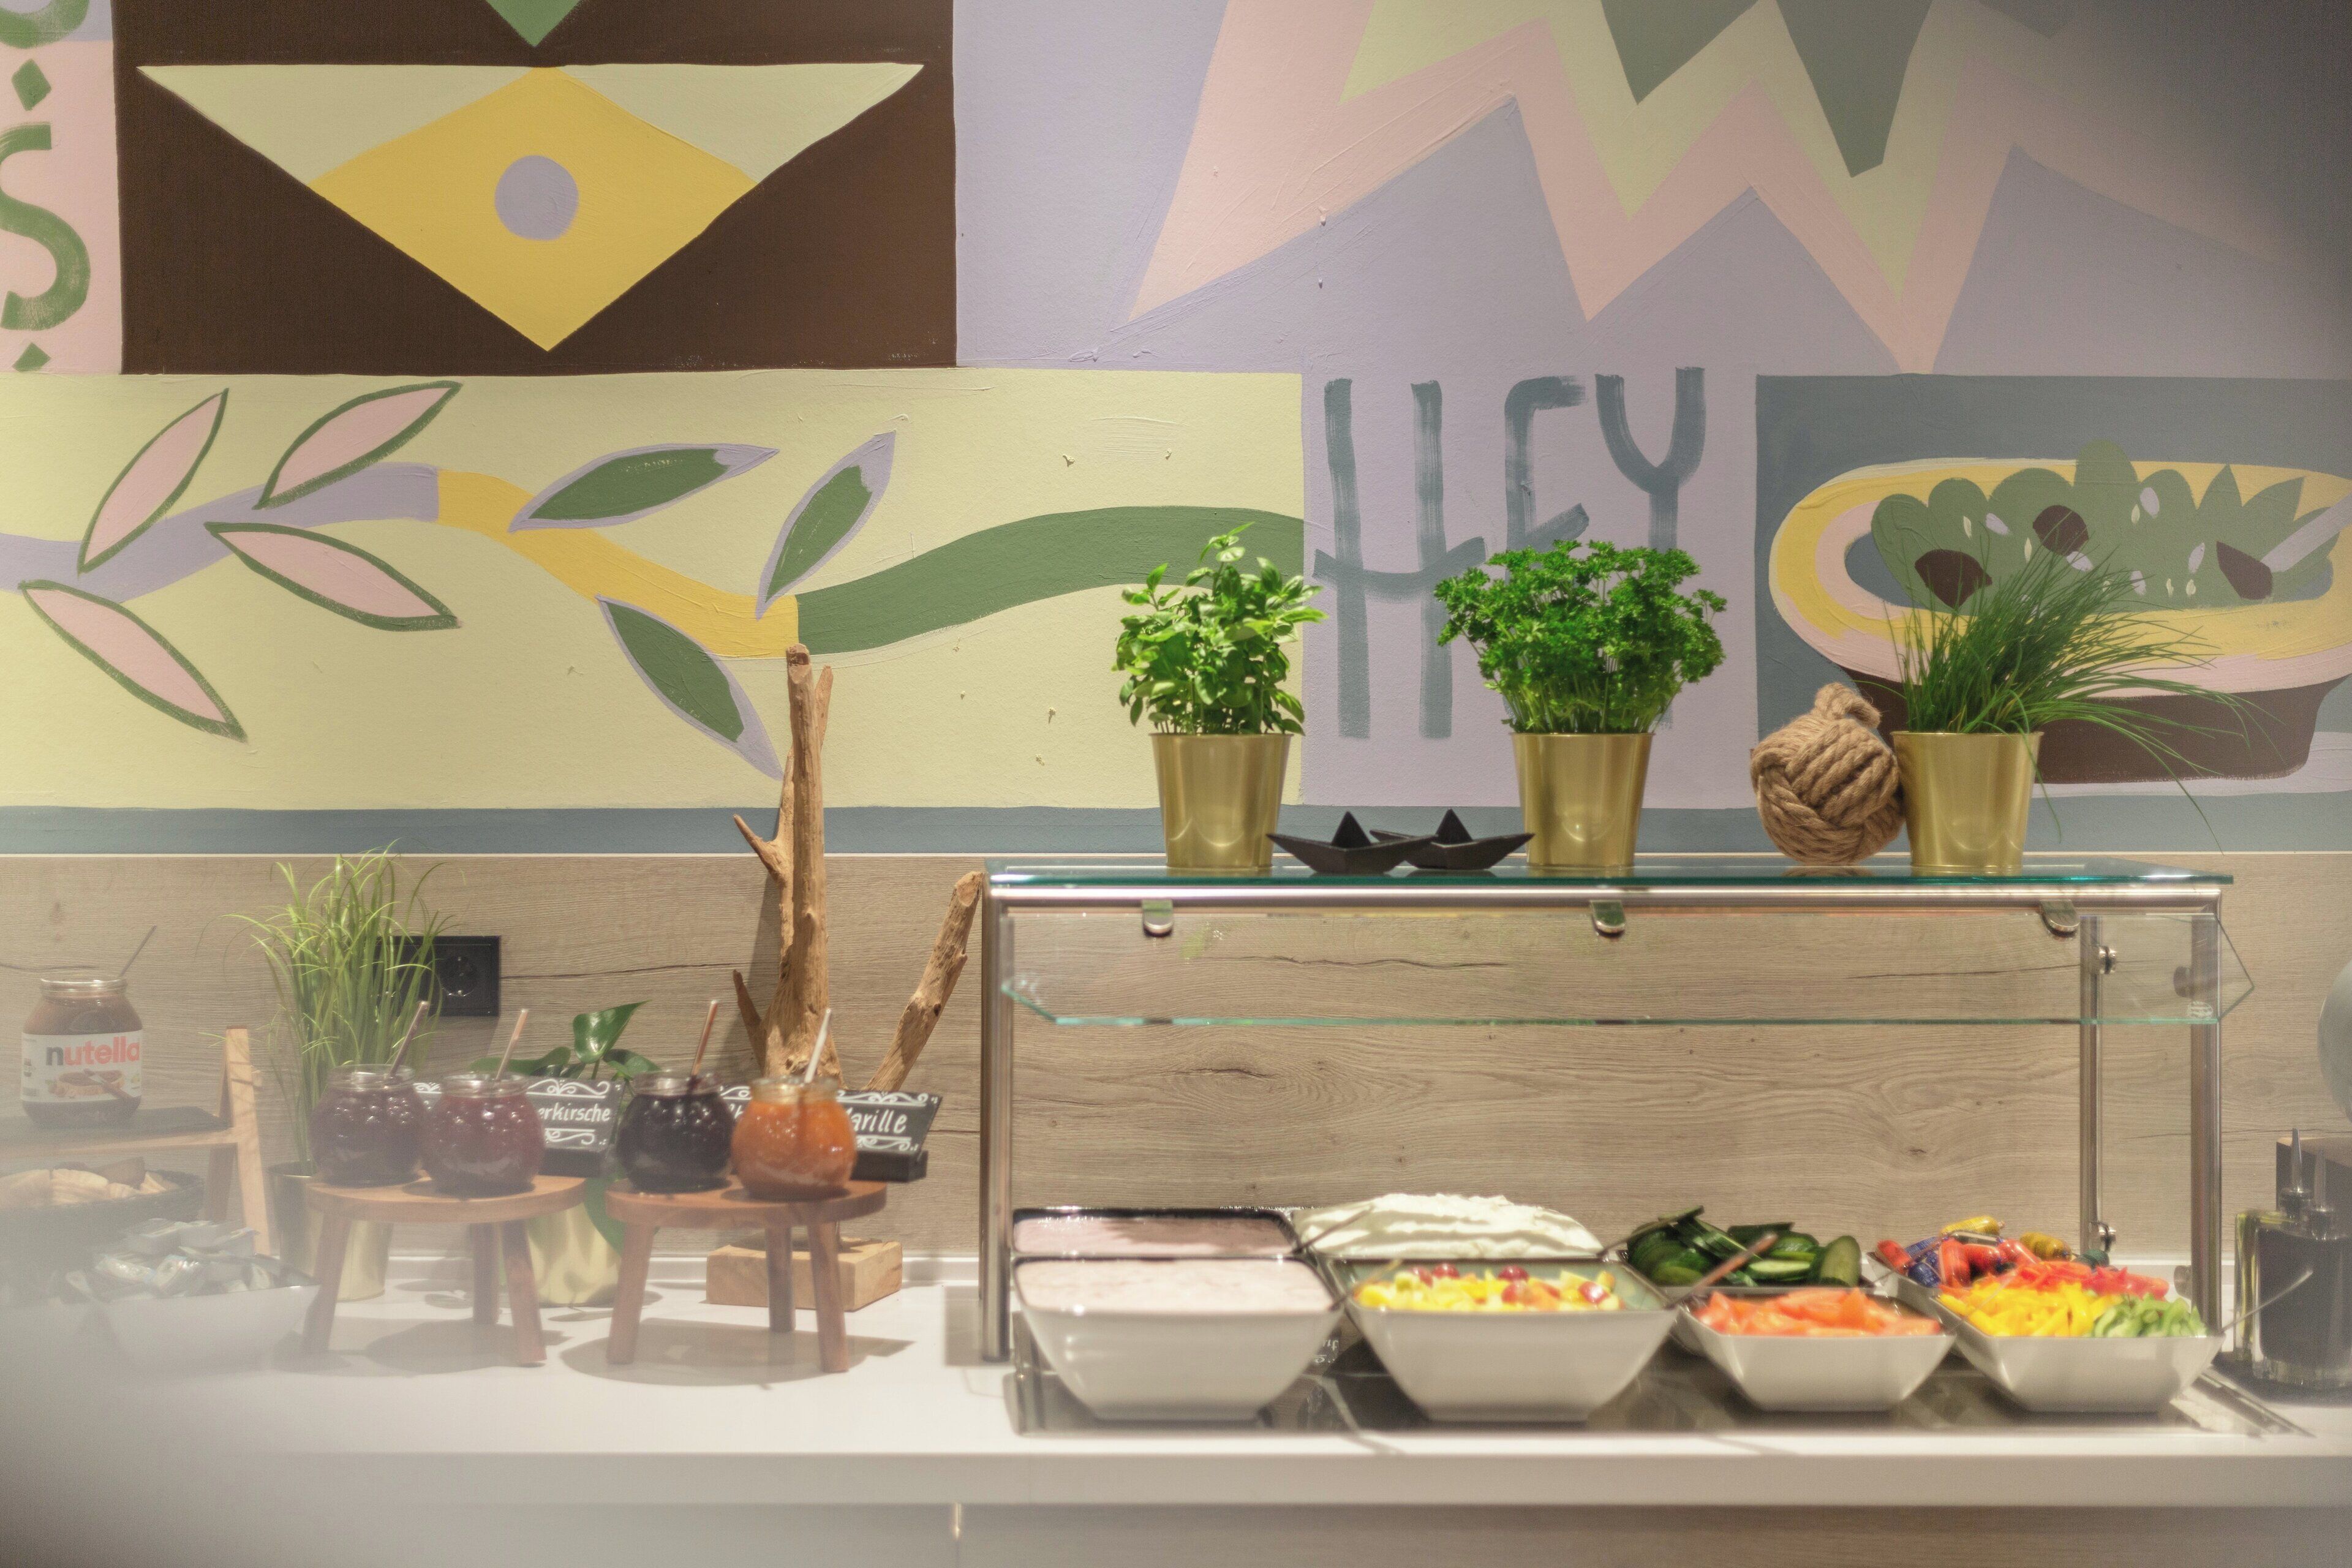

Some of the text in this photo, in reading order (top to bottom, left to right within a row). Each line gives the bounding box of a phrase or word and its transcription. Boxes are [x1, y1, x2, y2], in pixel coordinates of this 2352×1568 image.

[1311, 366, 1706, 739] HEY
[46, 1036, 140, 1066] nutella
[538, 1102, 611, 1123] erkirsche
[846, 1107, 908, 1134] arille
